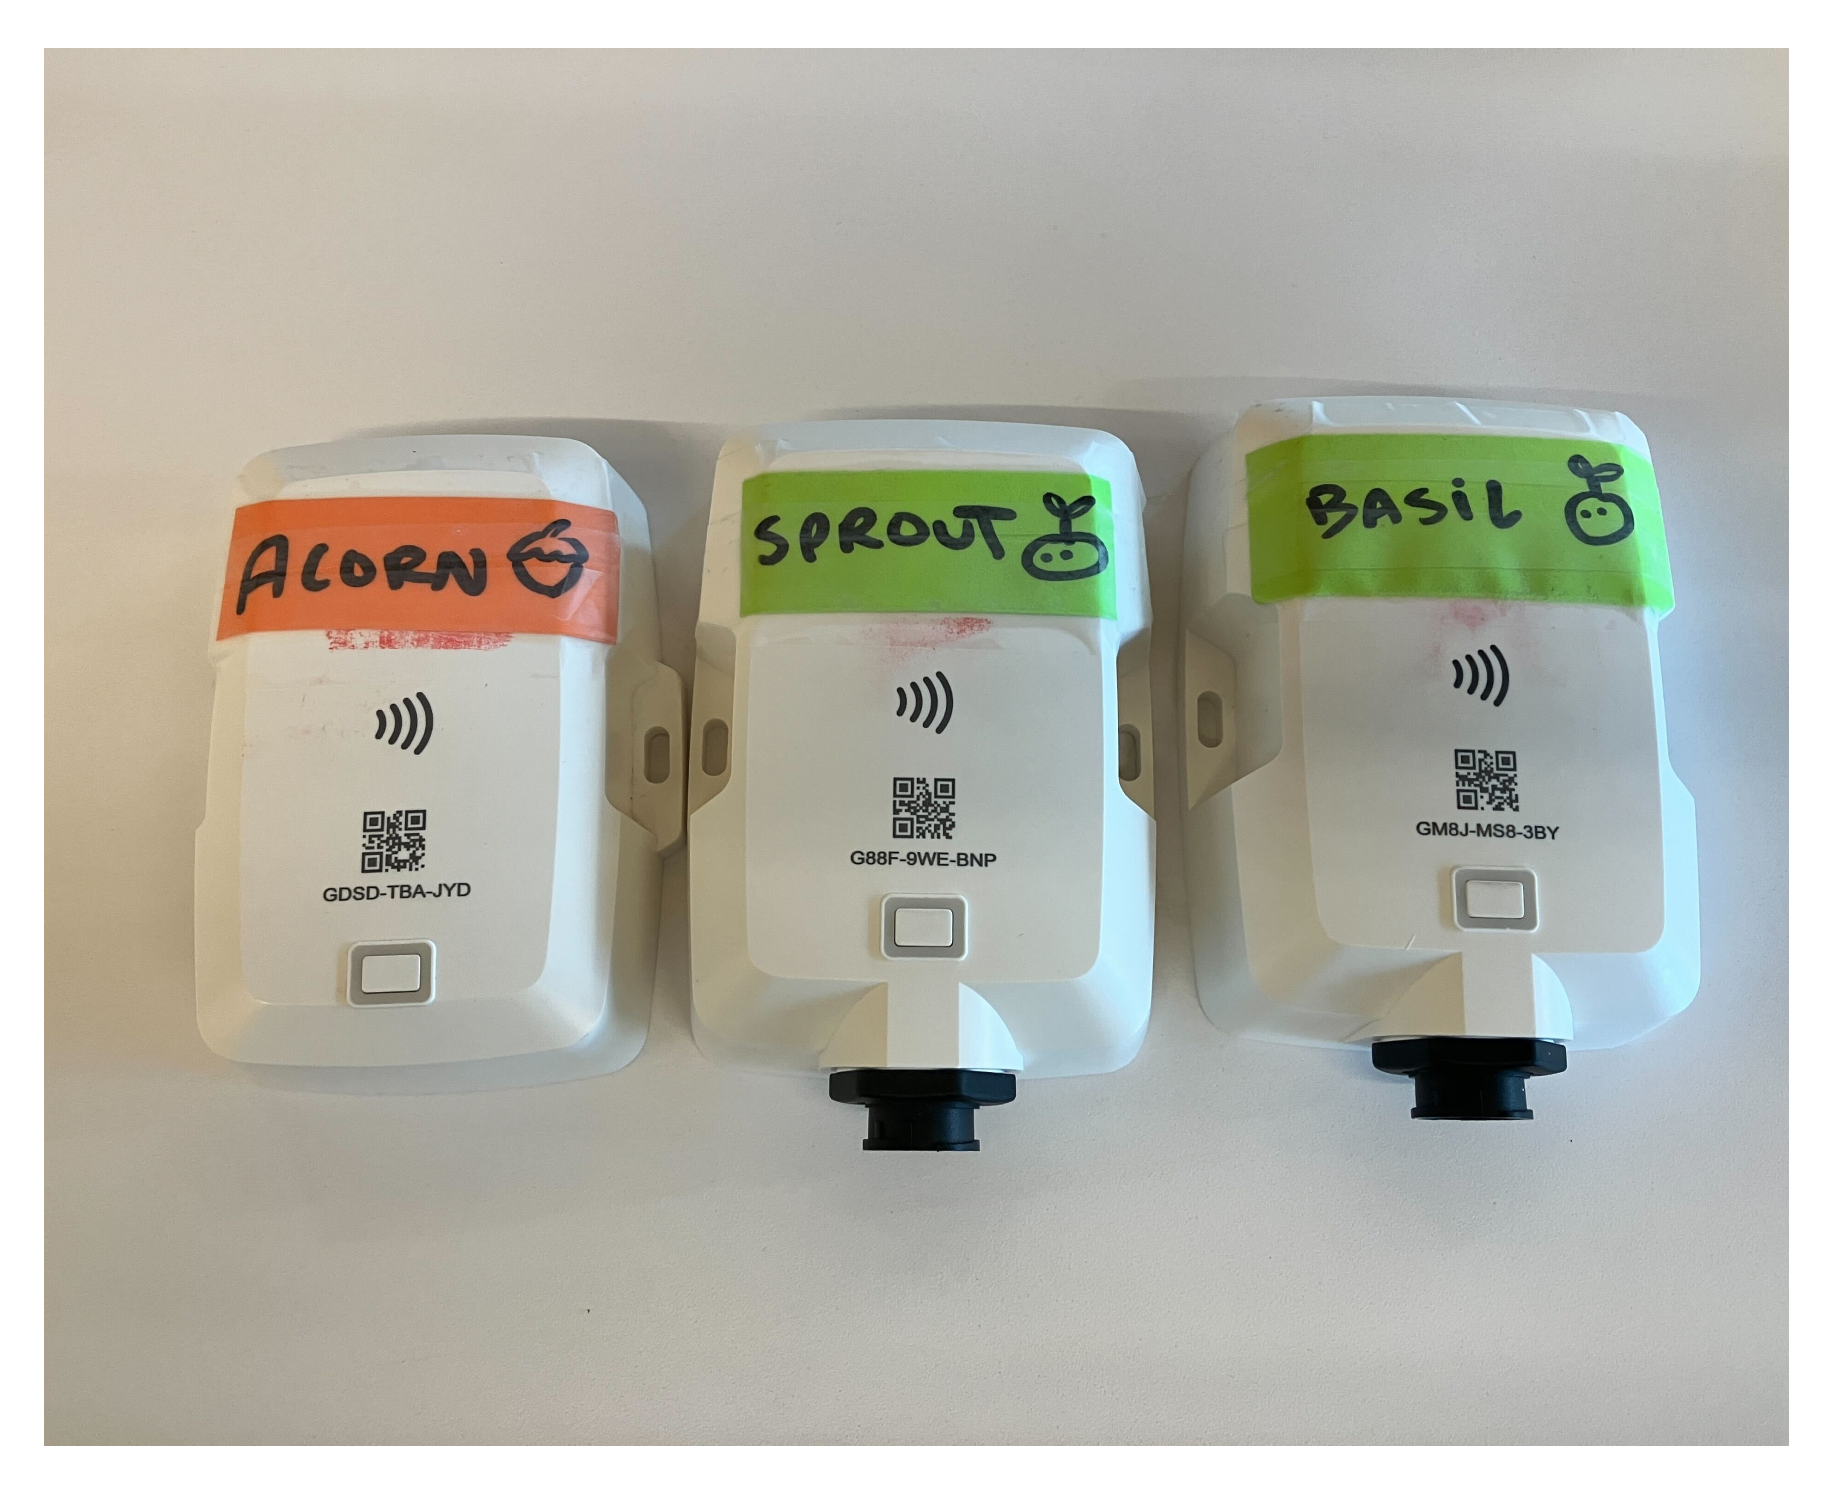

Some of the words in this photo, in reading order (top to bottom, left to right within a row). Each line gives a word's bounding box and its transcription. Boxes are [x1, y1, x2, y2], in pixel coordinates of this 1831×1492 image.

[754, 505, 1021, 566] SPROUT
[236, 534, 487, 615] ACORN
[1416, 821, 1559, 841] GM8J-MS8-3BY
[850, 851, 998, 868] G88F-9WE-BNP
[322, 882, 471, 902] GDSD-TBA-JYD
